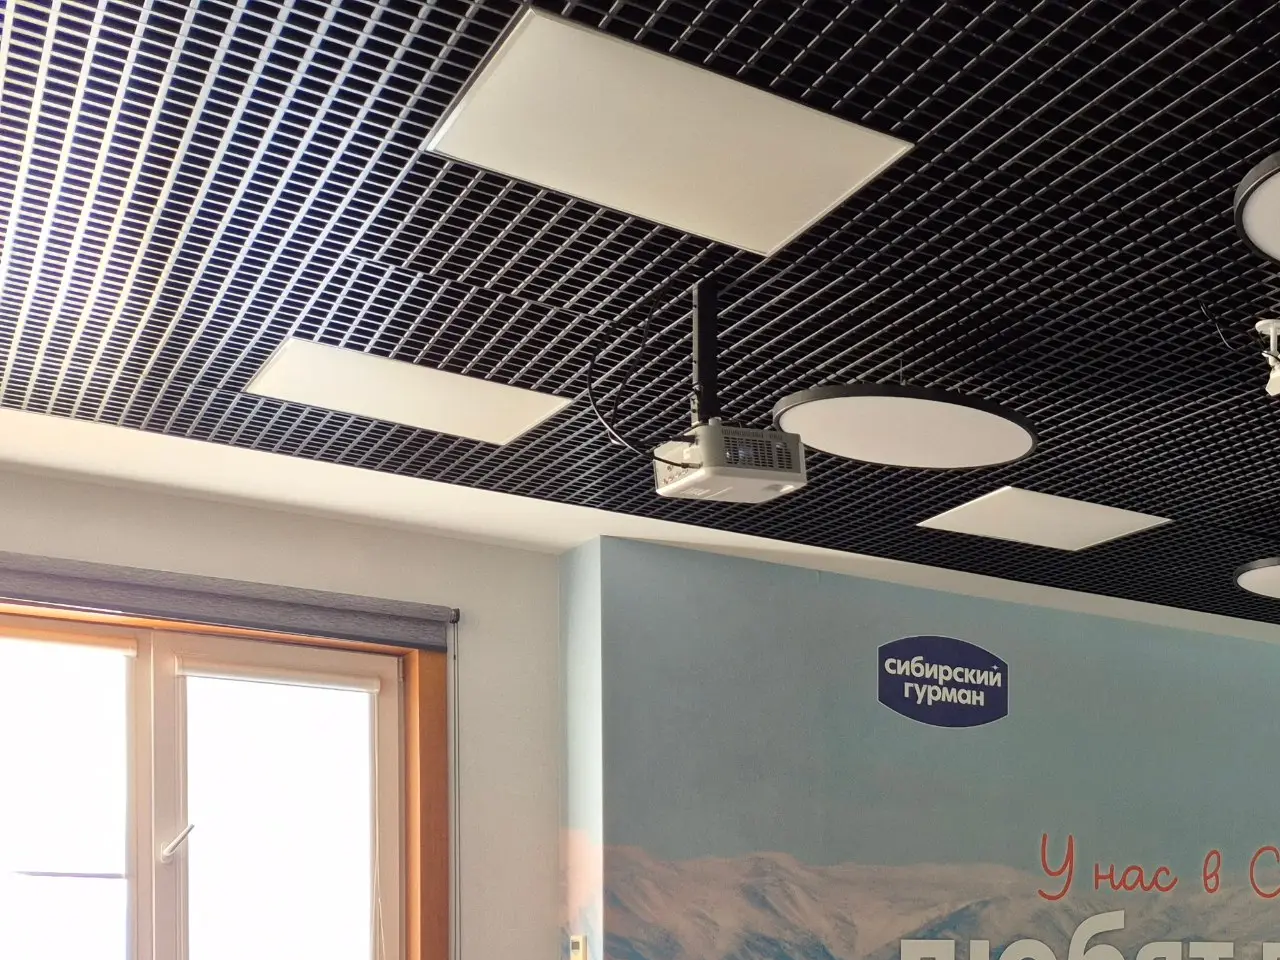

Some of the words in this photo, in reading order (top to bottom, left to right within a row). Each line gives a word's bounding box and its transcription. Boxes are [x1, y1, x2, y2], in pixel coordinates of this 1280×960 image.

[904, 682, 984, 706] гурман
[1036, 833, 1075, 901] У
[1094, 858, 1179, 892] нас
[1202, 849, 1222, 895] в
